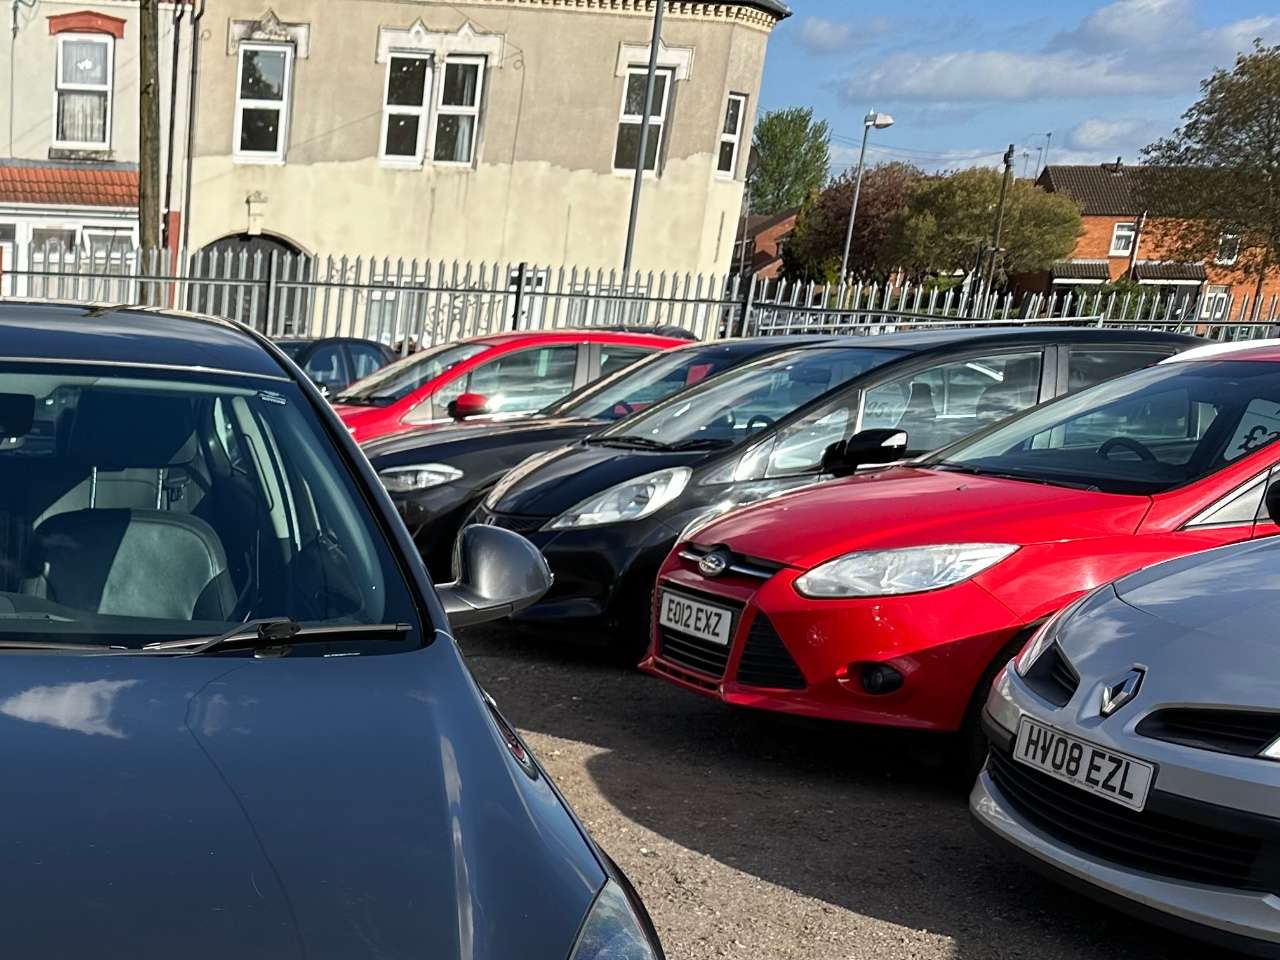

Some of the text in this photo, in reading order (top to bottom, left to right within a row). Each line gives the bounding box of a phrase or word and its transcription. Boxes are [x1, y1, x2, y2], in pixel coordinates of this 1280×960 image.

[693, 606, 723, 637] EXZ
[1024, 725, 1134, 800] HV08 EZL
